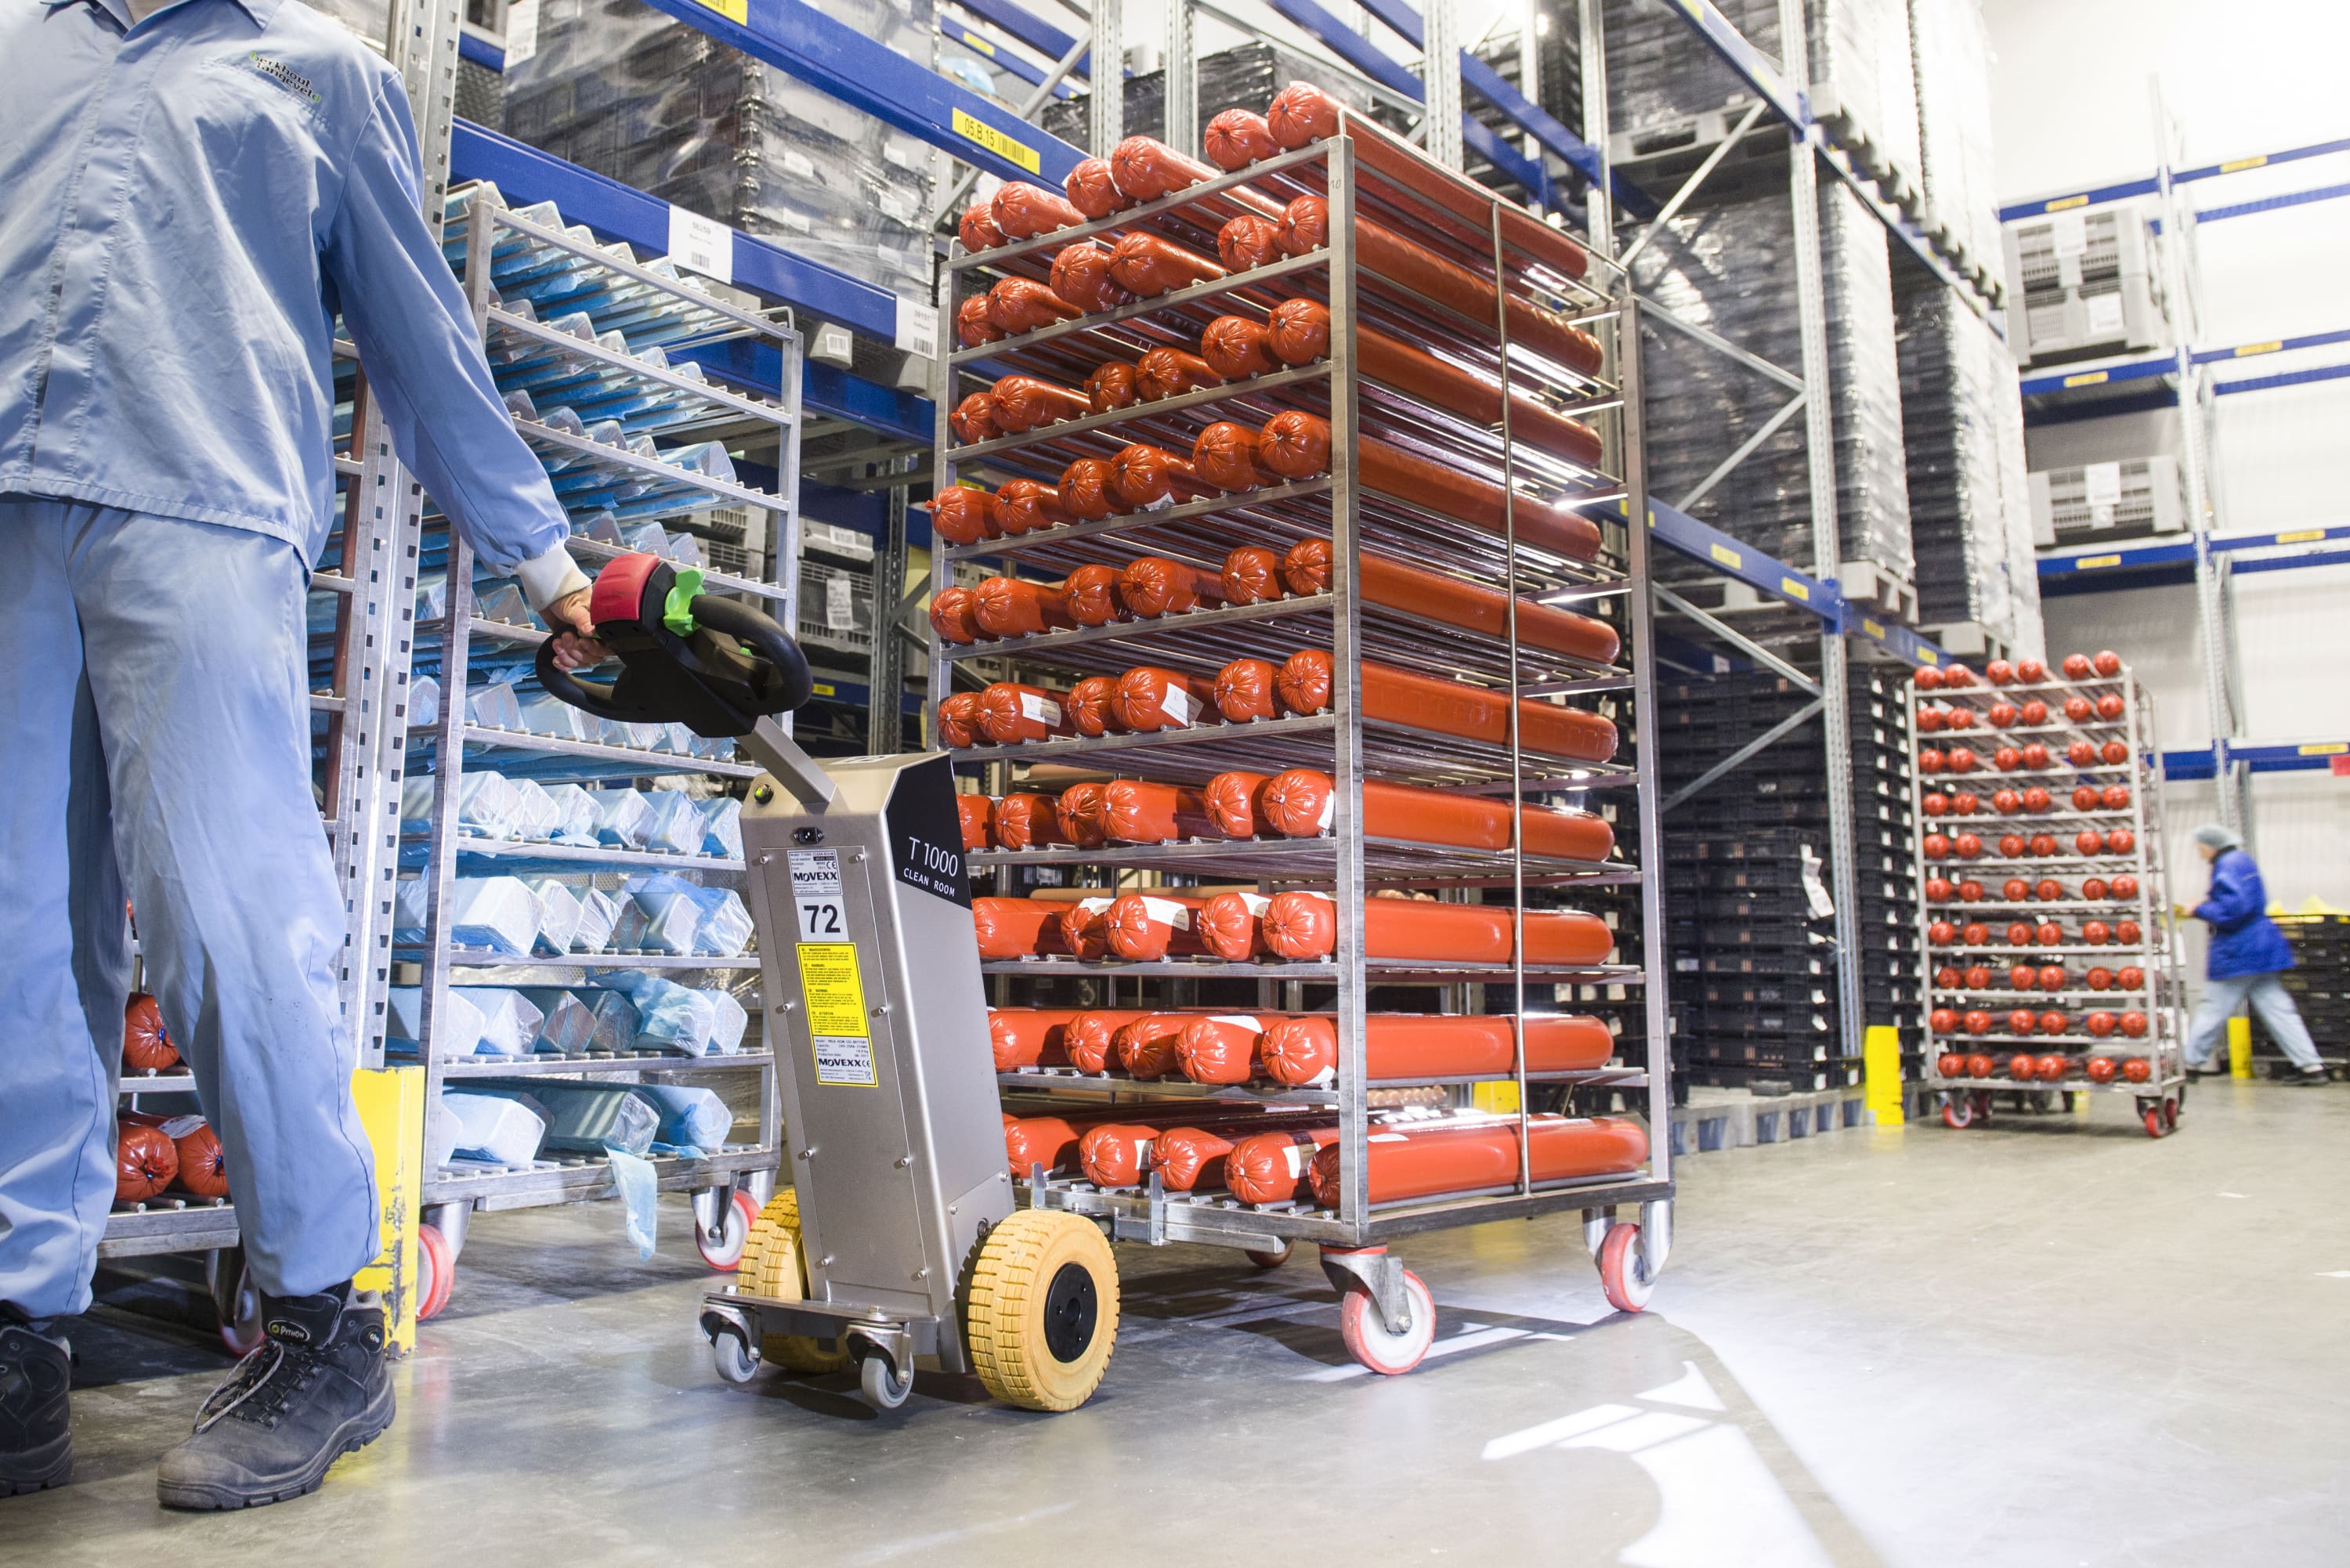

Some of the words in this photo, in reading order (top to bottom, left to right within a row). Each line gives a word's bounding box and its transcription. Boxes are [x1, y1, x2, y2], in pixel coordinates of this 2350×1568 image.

[251, 52, 312, 88] berkhout
[964, 117, 995, 147] 05.B.15
[909, 836, 921, 861] T
[924, 842, 958, 877] 1000
[794, 871, 837, 882] MOVEXX
[903, 867, 929, 887] CLEAN
[934, 880, 955, 898] ROOM
[803, 904, 841, 934] 72
[818, 1058, 862, 1067] MOVEXX
[280, 1325, 304, 1339] PYTHON
